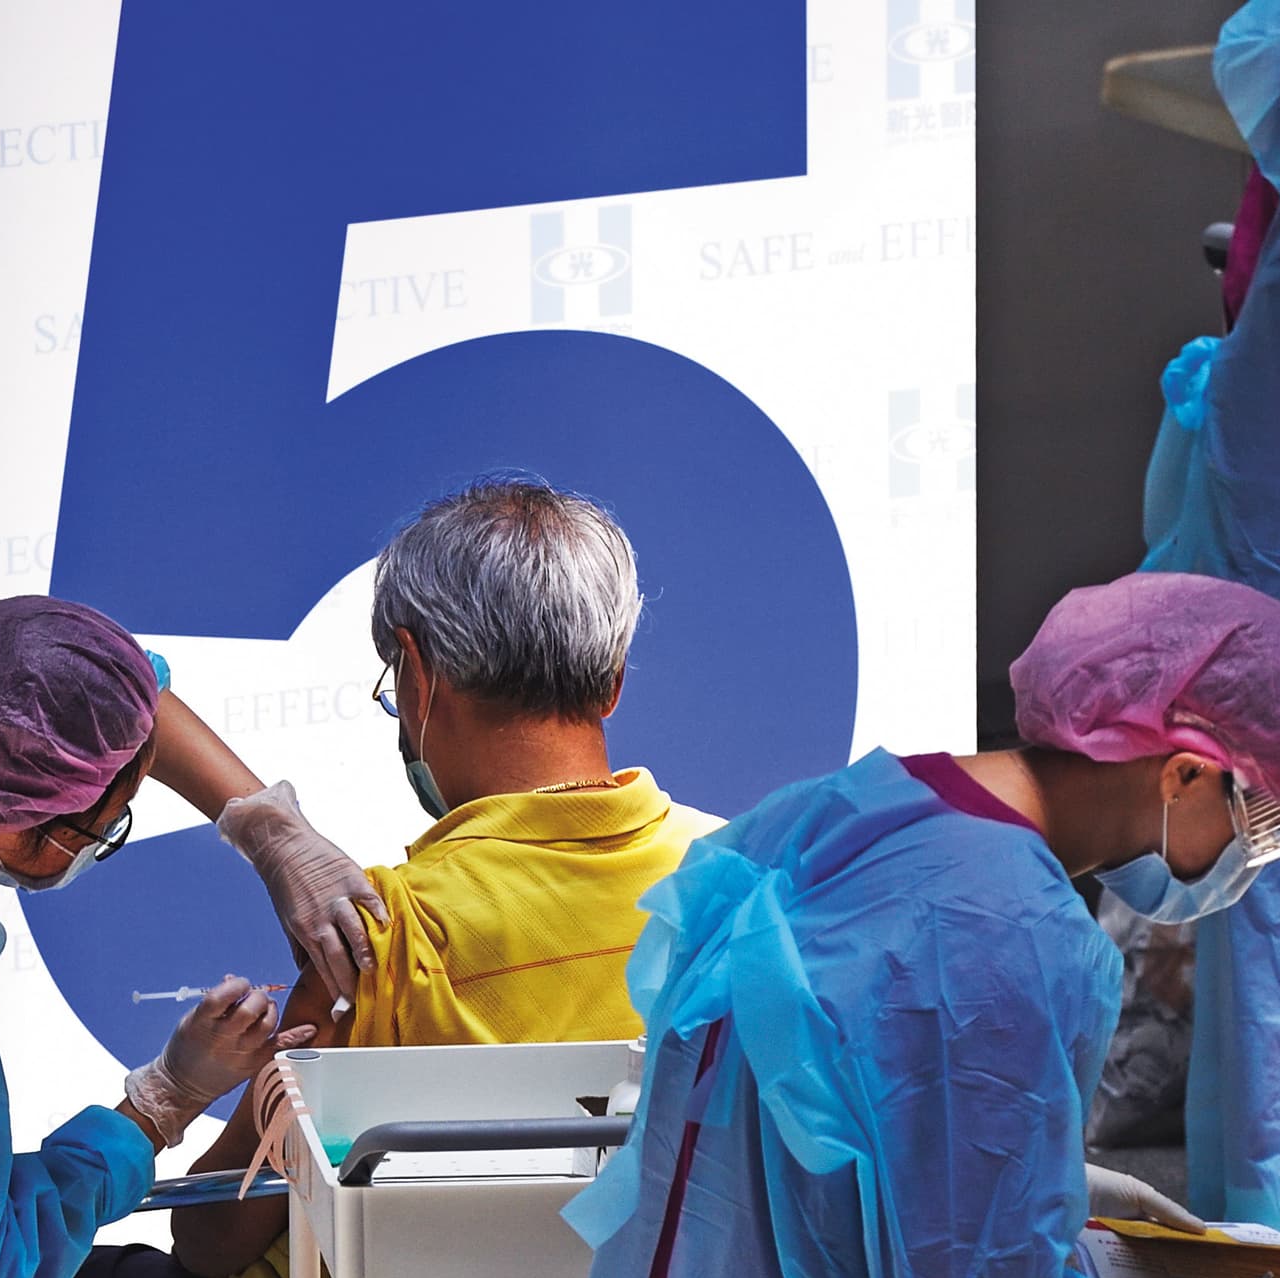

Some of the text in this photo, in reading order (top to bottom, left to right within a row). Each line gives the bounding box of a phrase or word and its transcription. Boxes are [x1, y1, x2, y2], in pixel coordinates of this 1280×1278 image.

[699, 216, 974, 281] SAFE and EFF
